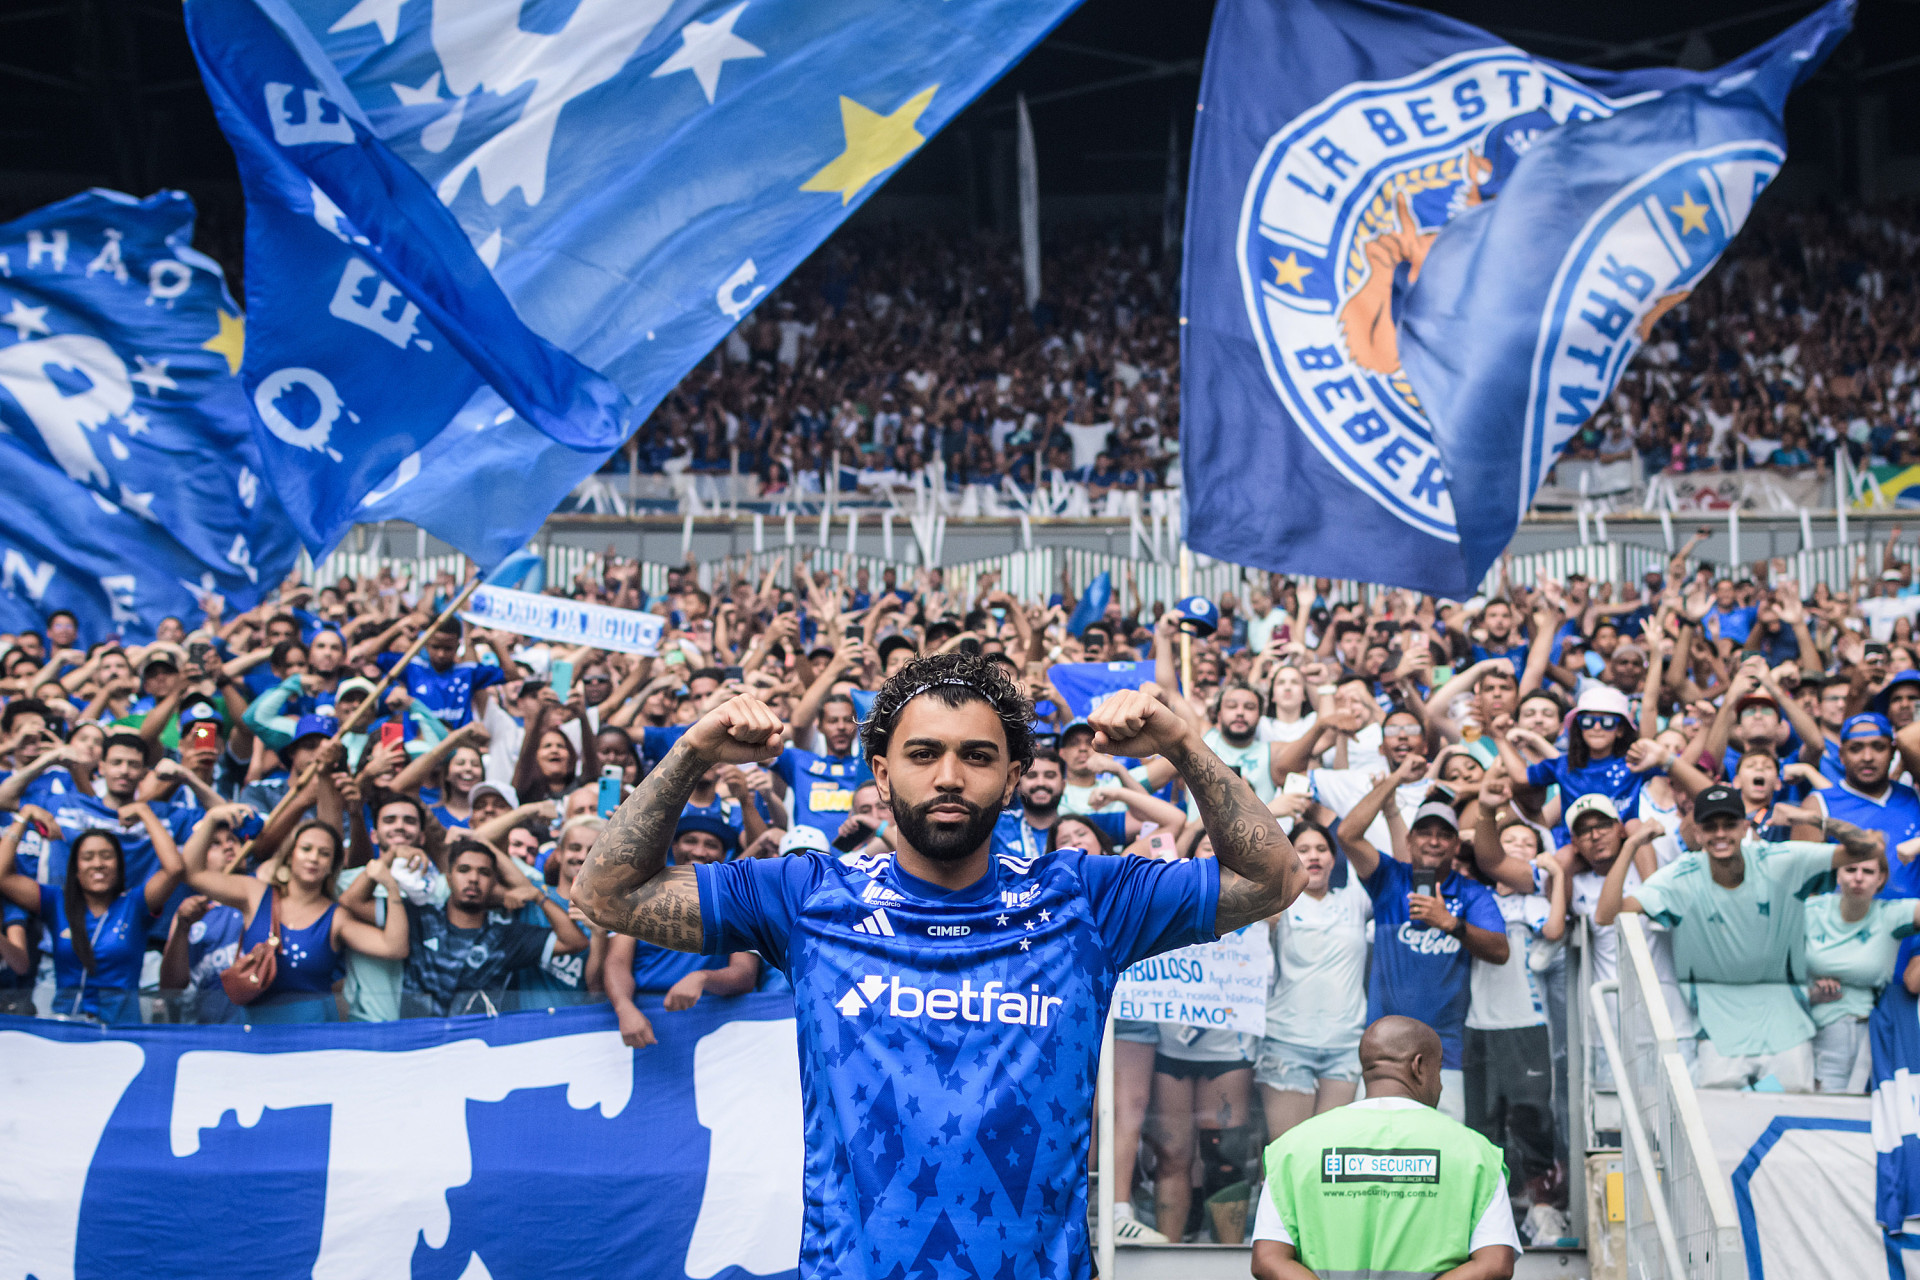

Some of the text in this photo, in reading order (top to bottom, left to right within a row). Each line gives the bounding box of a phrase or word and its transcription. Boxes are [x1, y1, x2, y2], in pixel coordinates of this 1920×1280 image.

[1294, 344, 1448, 509] BEBER
[927, 925, 971, 937] CIMED
[889, 975, 1063, 1027] betfair
[1120, 1000, 1227, 1025] EU TE AMO
[1348, 1157, 1365, 1172] CY
[1371, 1158, 1433, 1173] SECURITY
[1322, 1187, 1438, 1199] www.cysecuritymg.com.br
